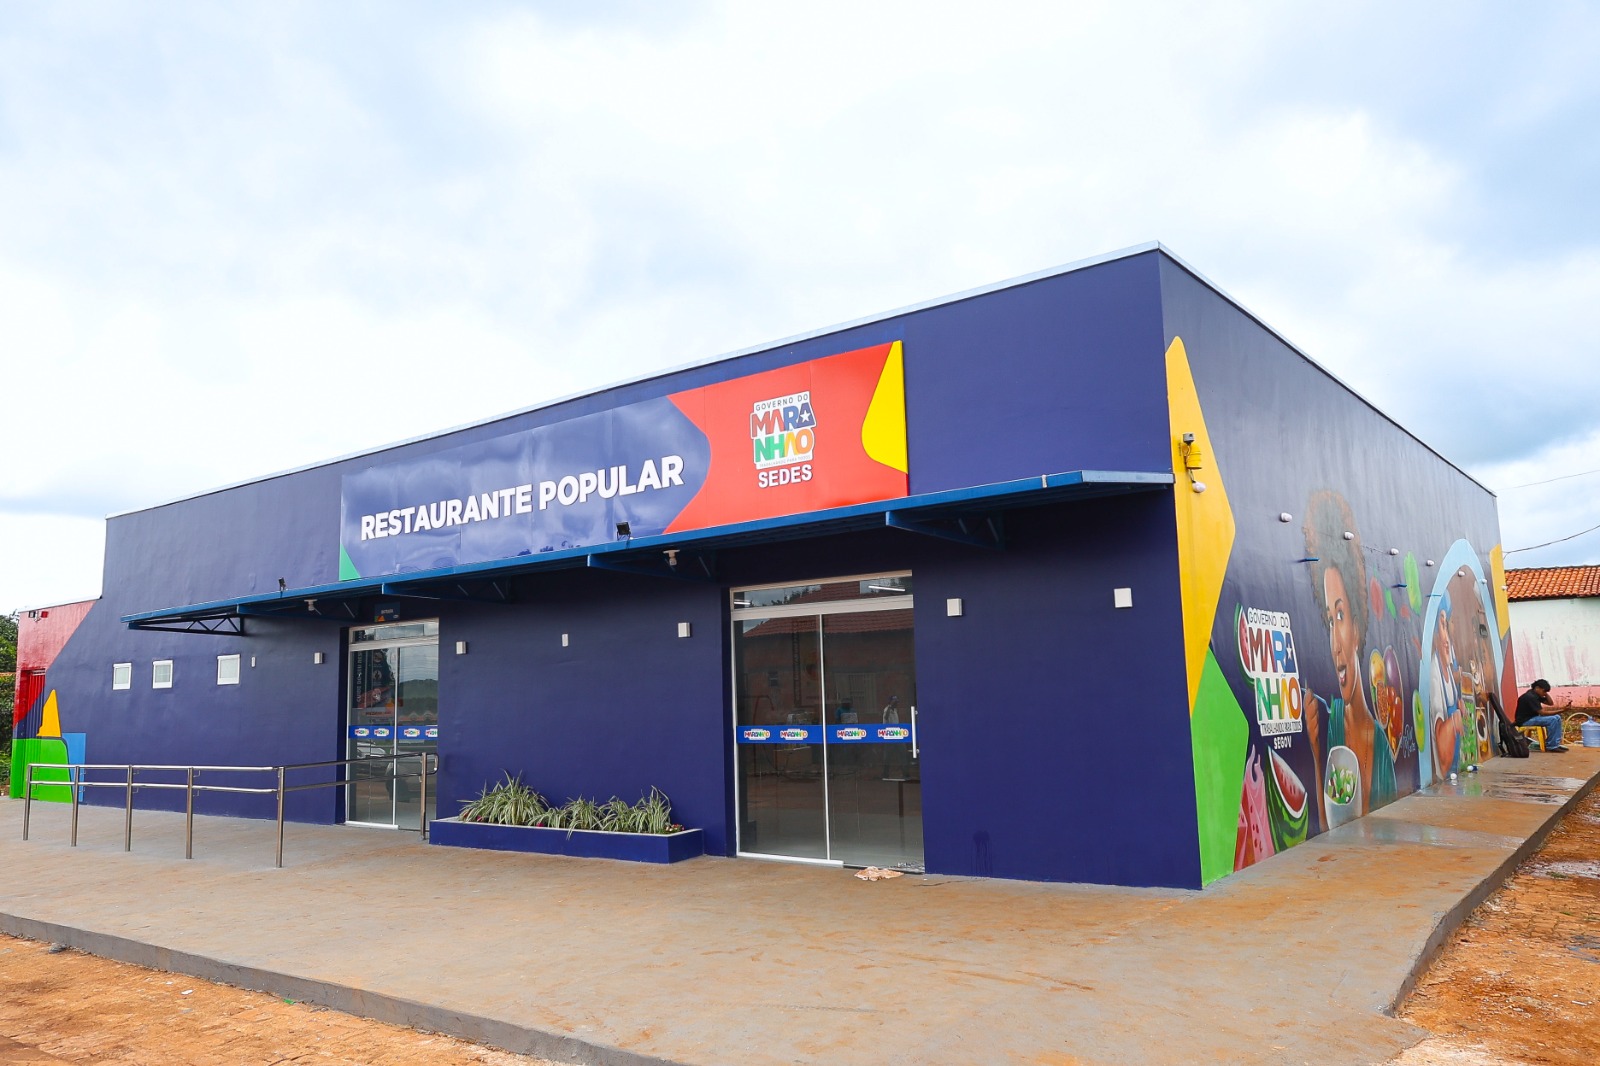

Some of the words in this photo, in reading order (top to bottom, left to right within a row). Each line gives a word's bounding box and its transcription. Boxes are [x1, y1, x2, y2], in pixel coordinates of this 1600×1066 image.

[756, 396, 793, 411] GOVERNO
[797, 393, 809, 402] DO
[758, 464, 813, 488] SEDES
[361, 483, 533, 541] RESTAURANTE
[539, 455, 685, 511] POPULAR
[1248, 611, 1277, 626] GOVERNO
[1280, 616, 1290, 629] DO
[1274, 735, 1292, 749] SEGOV
